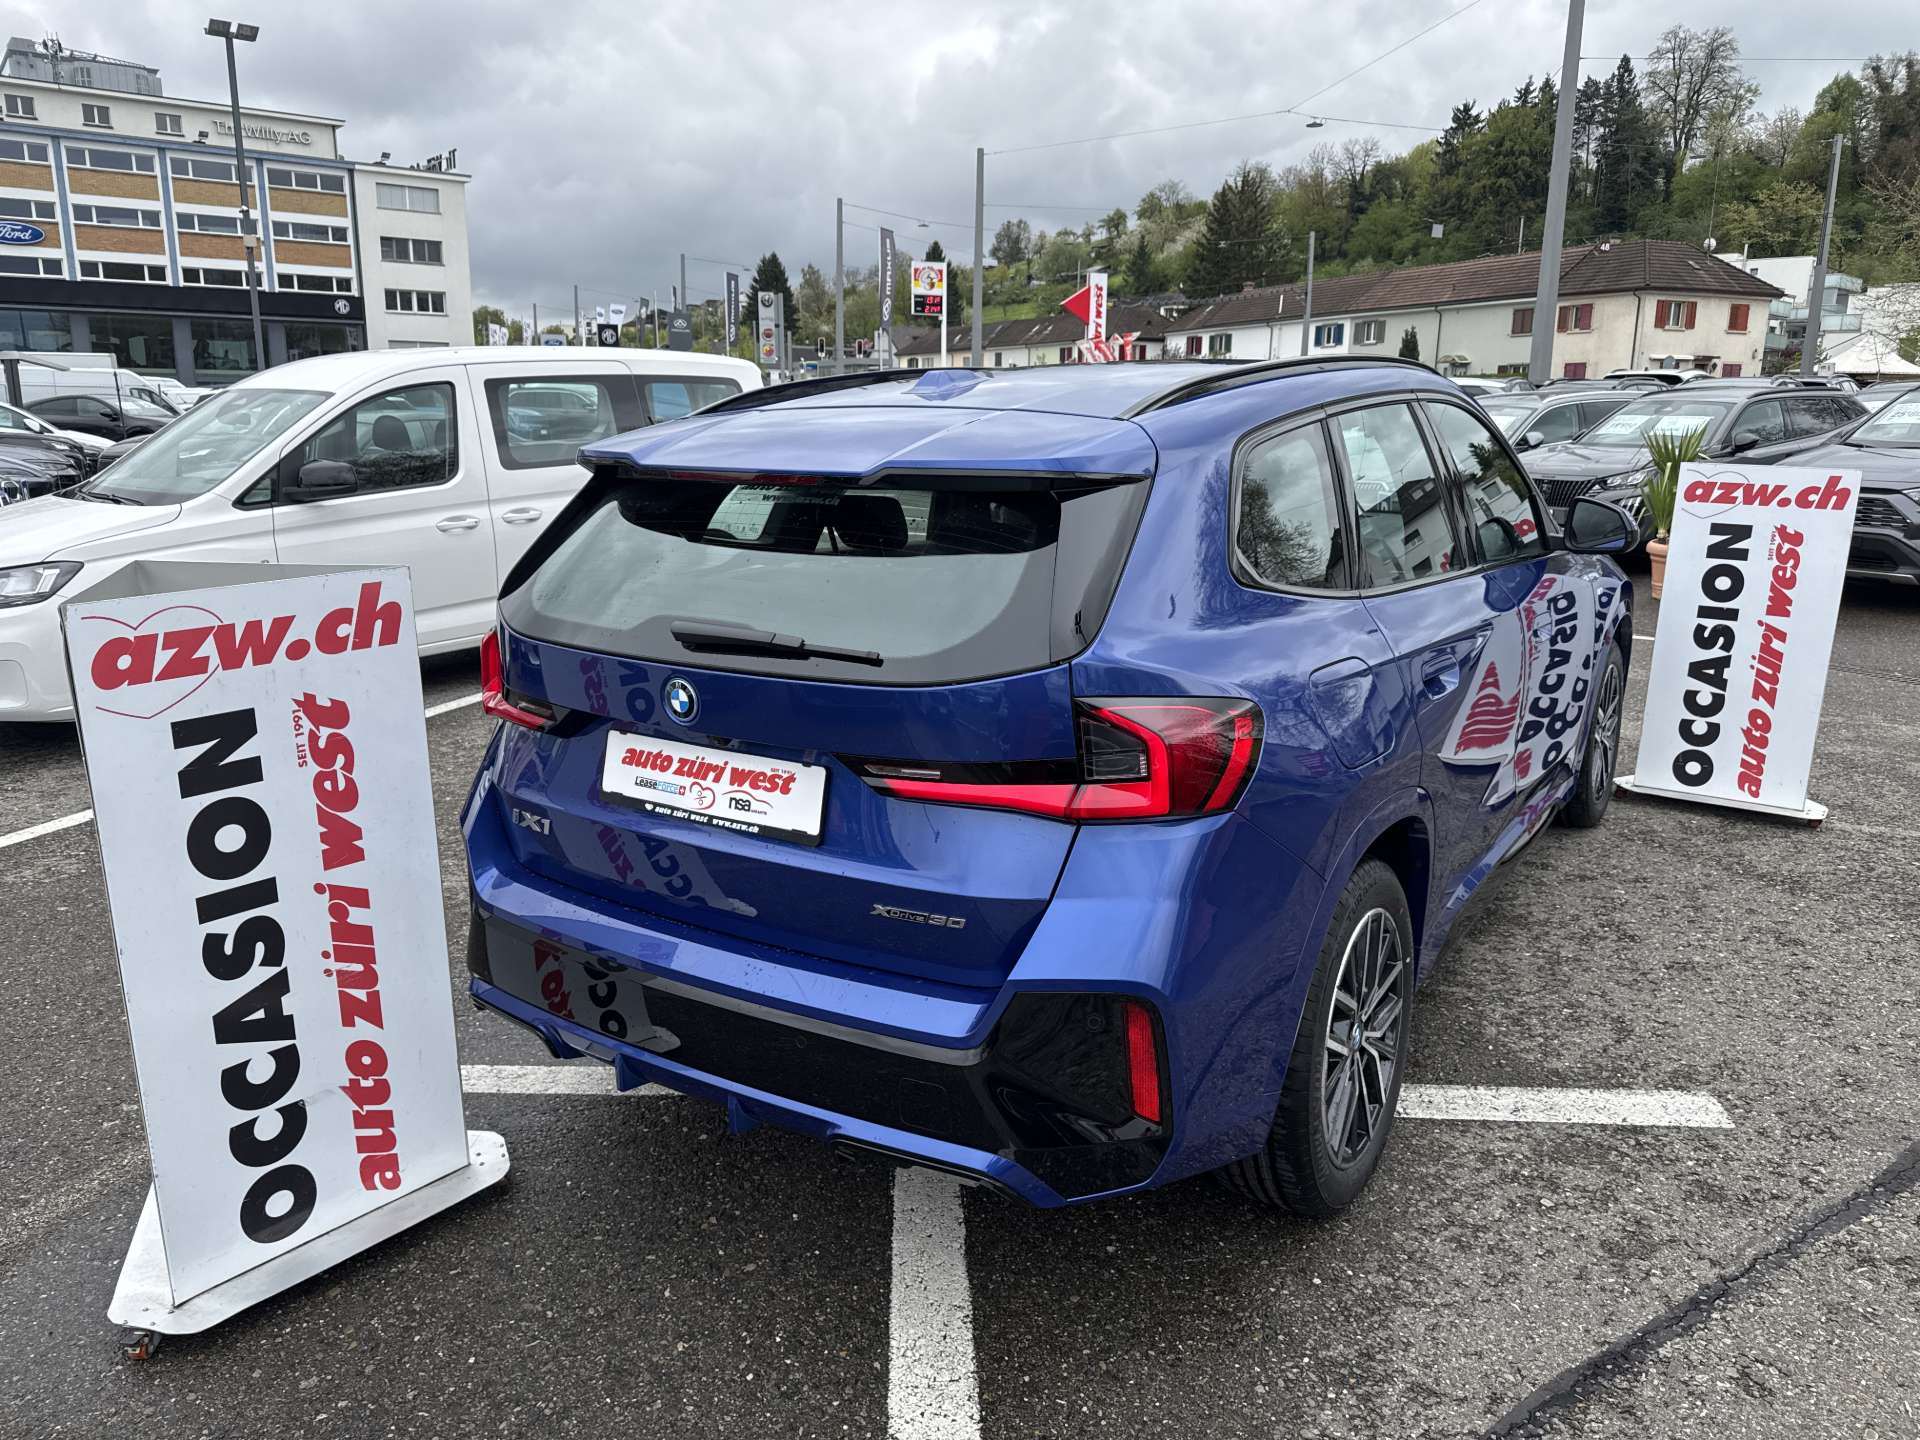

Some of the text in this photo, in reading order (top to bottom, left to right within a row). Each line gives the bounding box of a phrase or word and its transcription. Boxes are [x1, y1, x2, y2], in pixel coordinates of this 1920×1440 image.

[243, 124, 282, 144] Willy
[287, 129, 311, 144] AG
[0, 223, 32, 240] Ford
[1684, 475, 1851, 510] azw.ch
[92, 582, 402, 690] azw.ch
[1672, 522, 1753, 787] OCCASION
[1738, 524, 1805, 798] auto züri west
[297, 742, 308, 768] SEIT
[621, 746, 797, 795] auto züri west
[654, 806, 760, 834] auto züri west www.azw.ch
[728, 795, 751, 813] nsa
[293, 692, 401, 1192] auto züri west
[171, 707, 317, 1244] OCCASION
